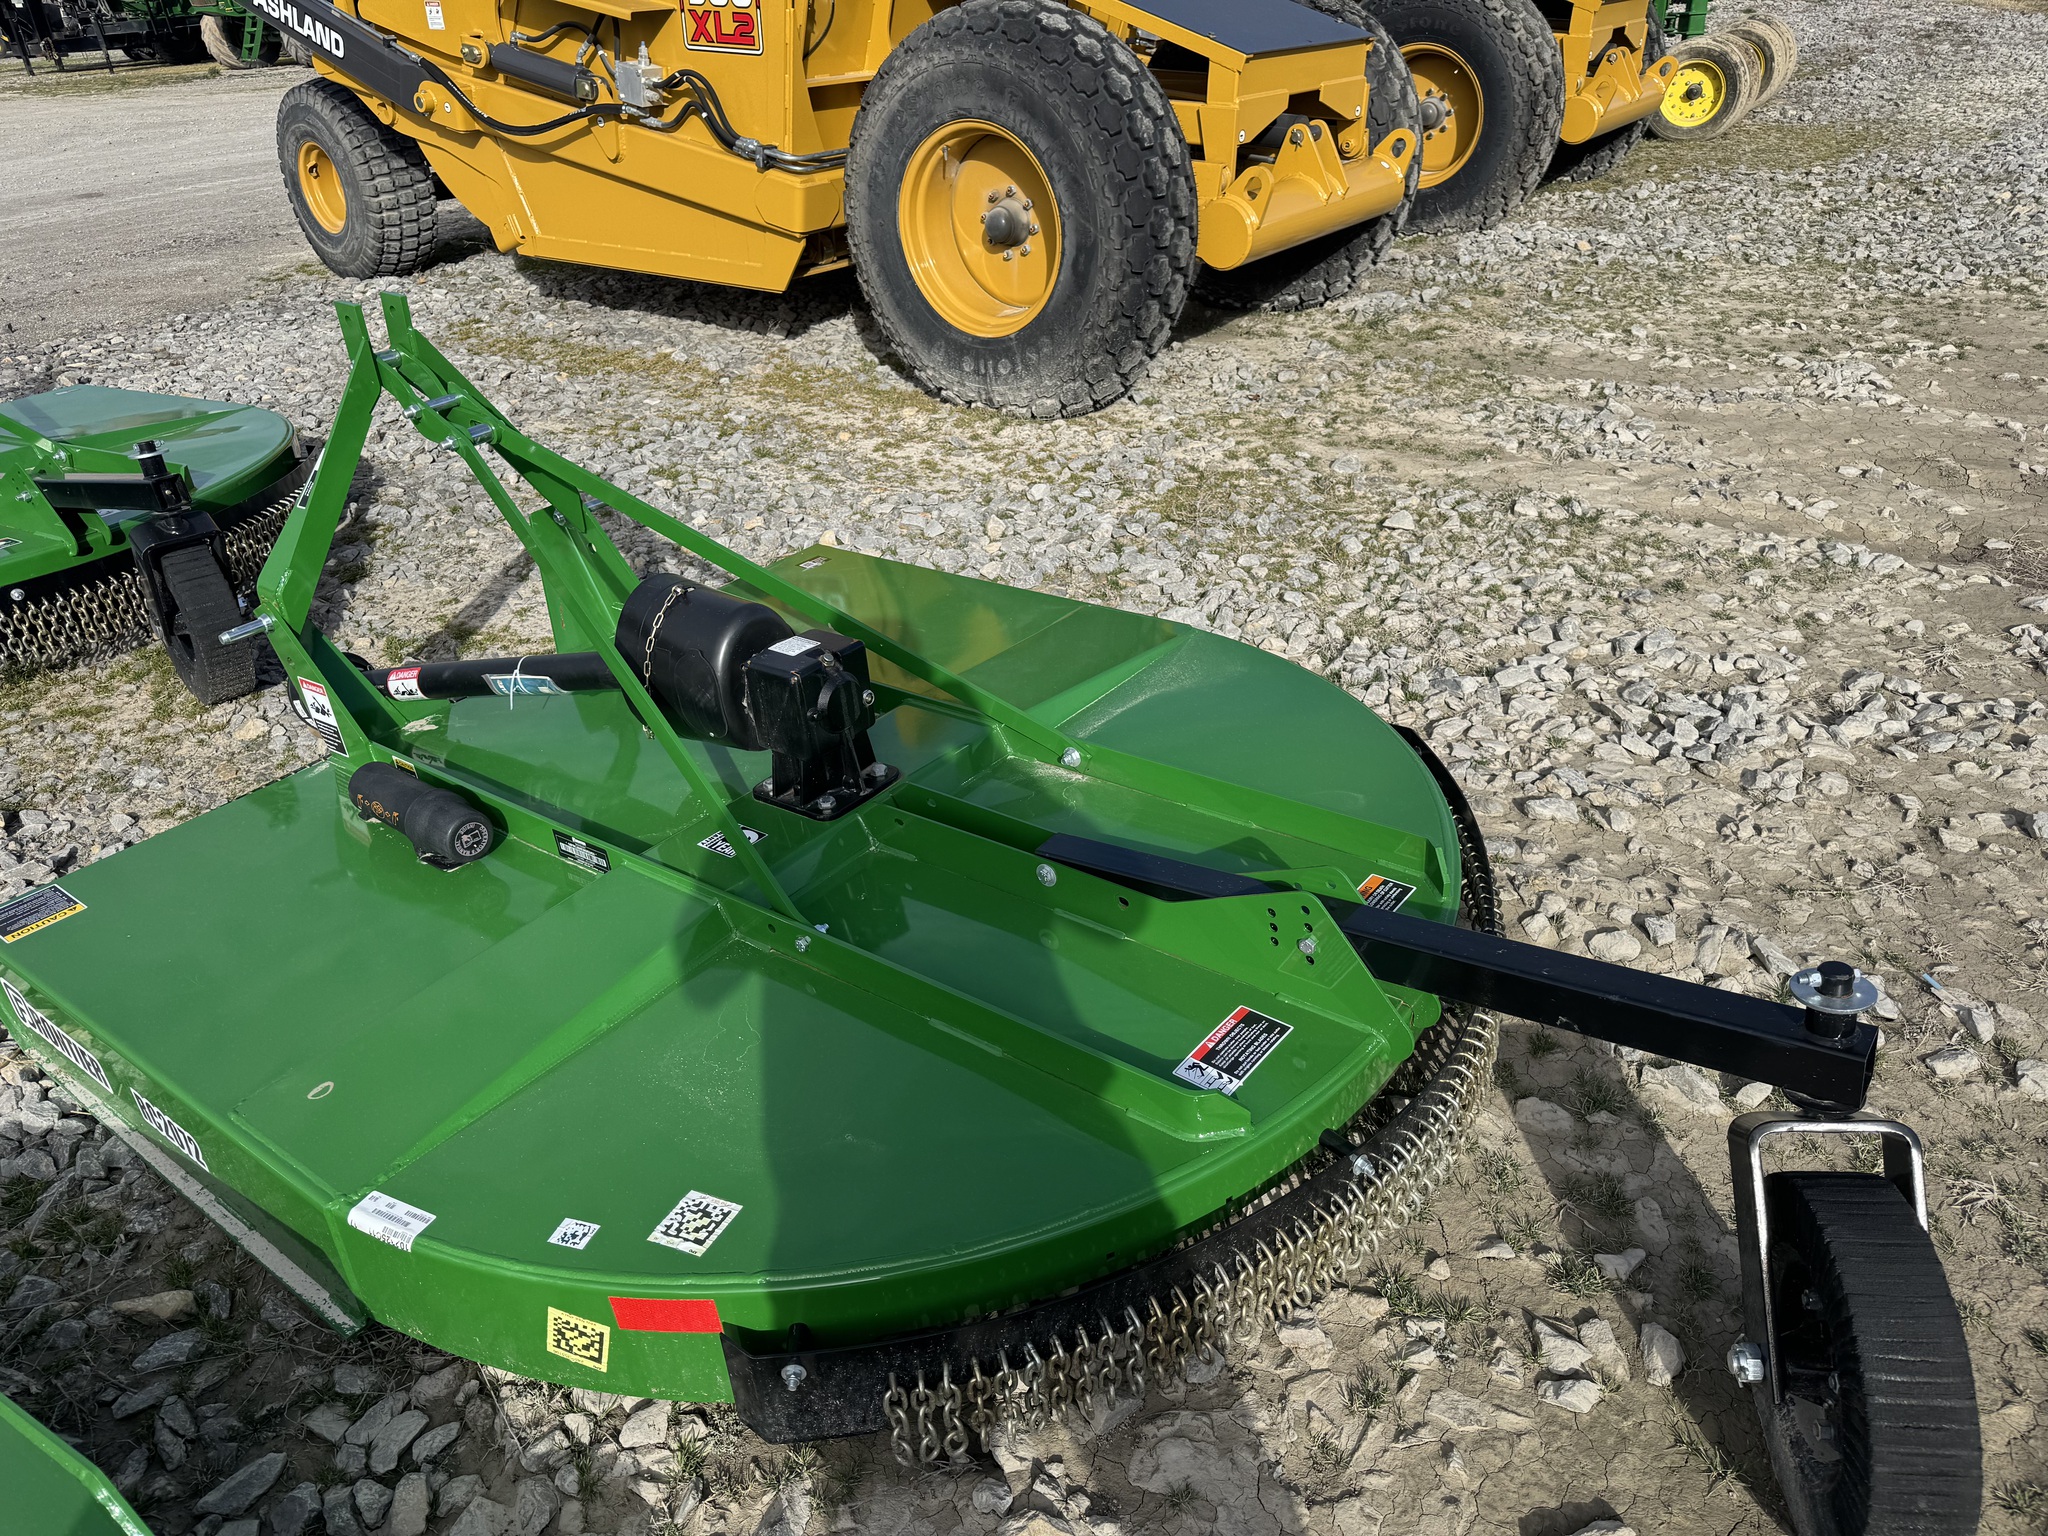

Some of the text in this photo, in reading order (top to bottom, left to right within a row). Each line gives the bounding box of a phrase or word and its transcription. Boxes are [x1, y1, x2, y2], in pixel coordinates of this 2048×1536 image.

[253, 0, 345, 59] ASHLAND
[687, 9, 755, 47] XL2
[11, 911, 67, 939] CAUTION
[1, 979, 112, 1094] FRONTIER
[1211, 1018, 1238, 1043] DANGER
[131, 1089, 208, 1171] RC2072
